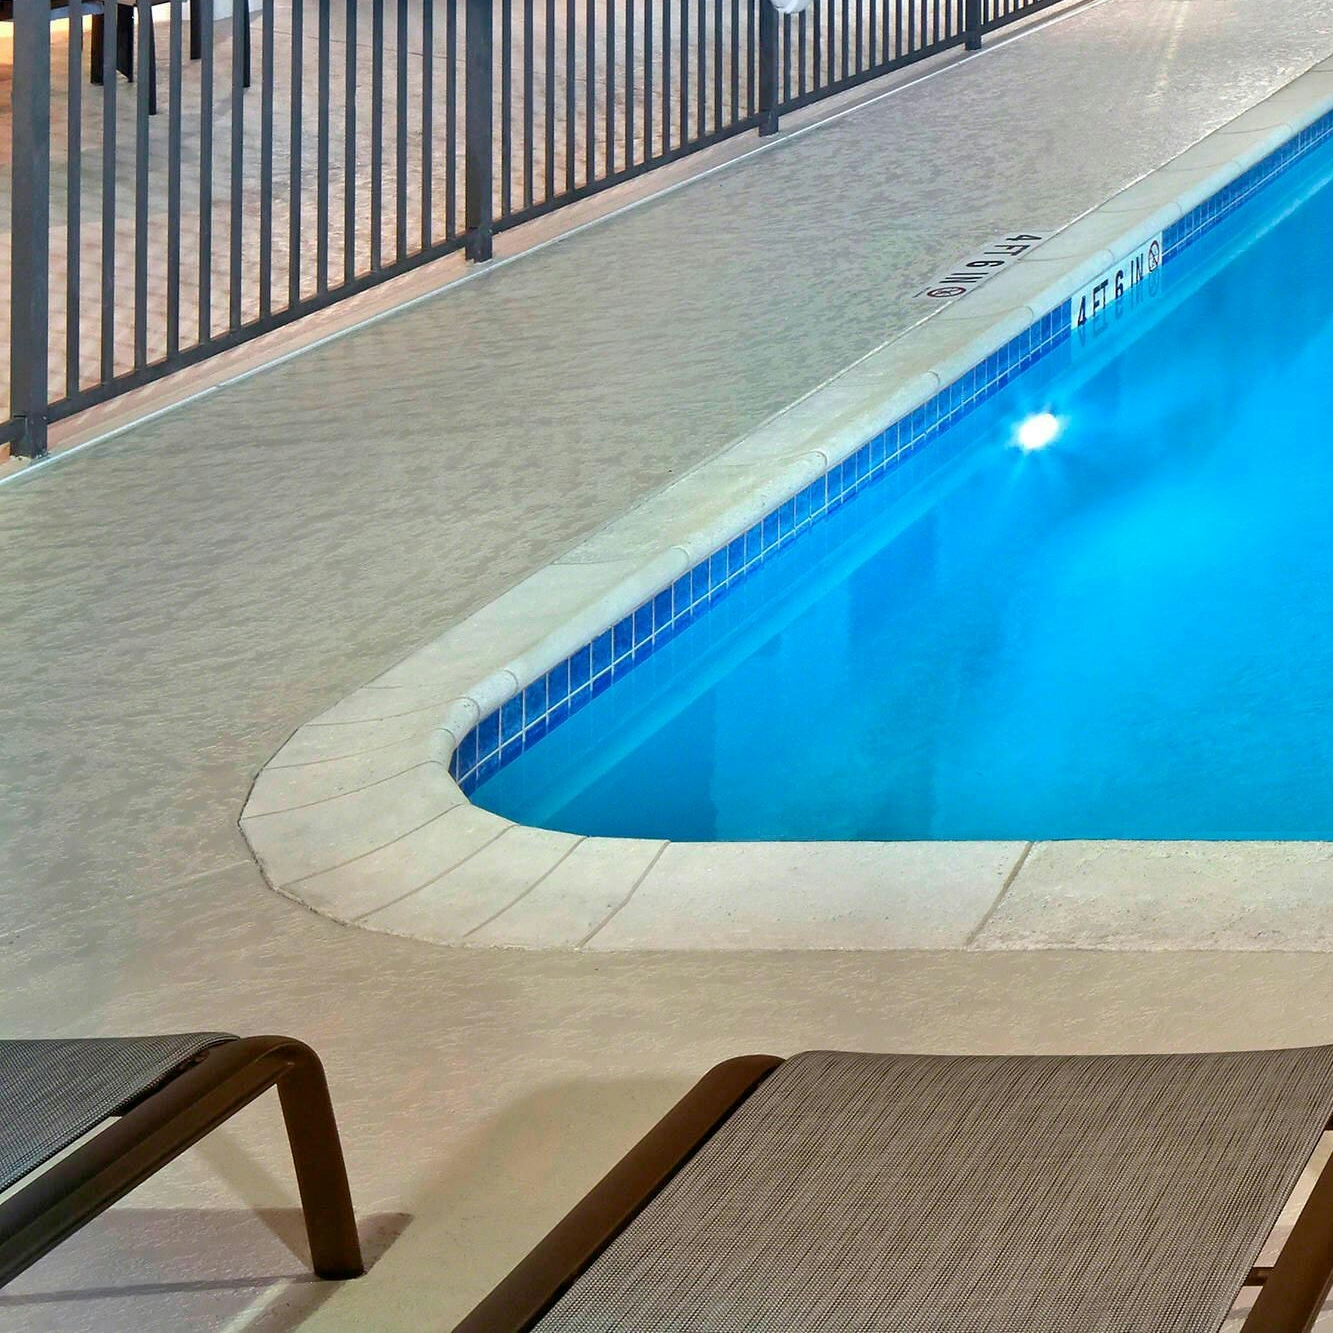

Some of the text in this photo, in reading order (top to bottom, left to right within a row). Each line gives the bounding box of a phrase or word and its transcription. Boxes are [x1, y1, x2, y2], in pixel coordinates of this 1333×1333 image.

[983, 245, 1031, 256] FT
[1077, 253, 1143, 326] 4 FT 6 IN
